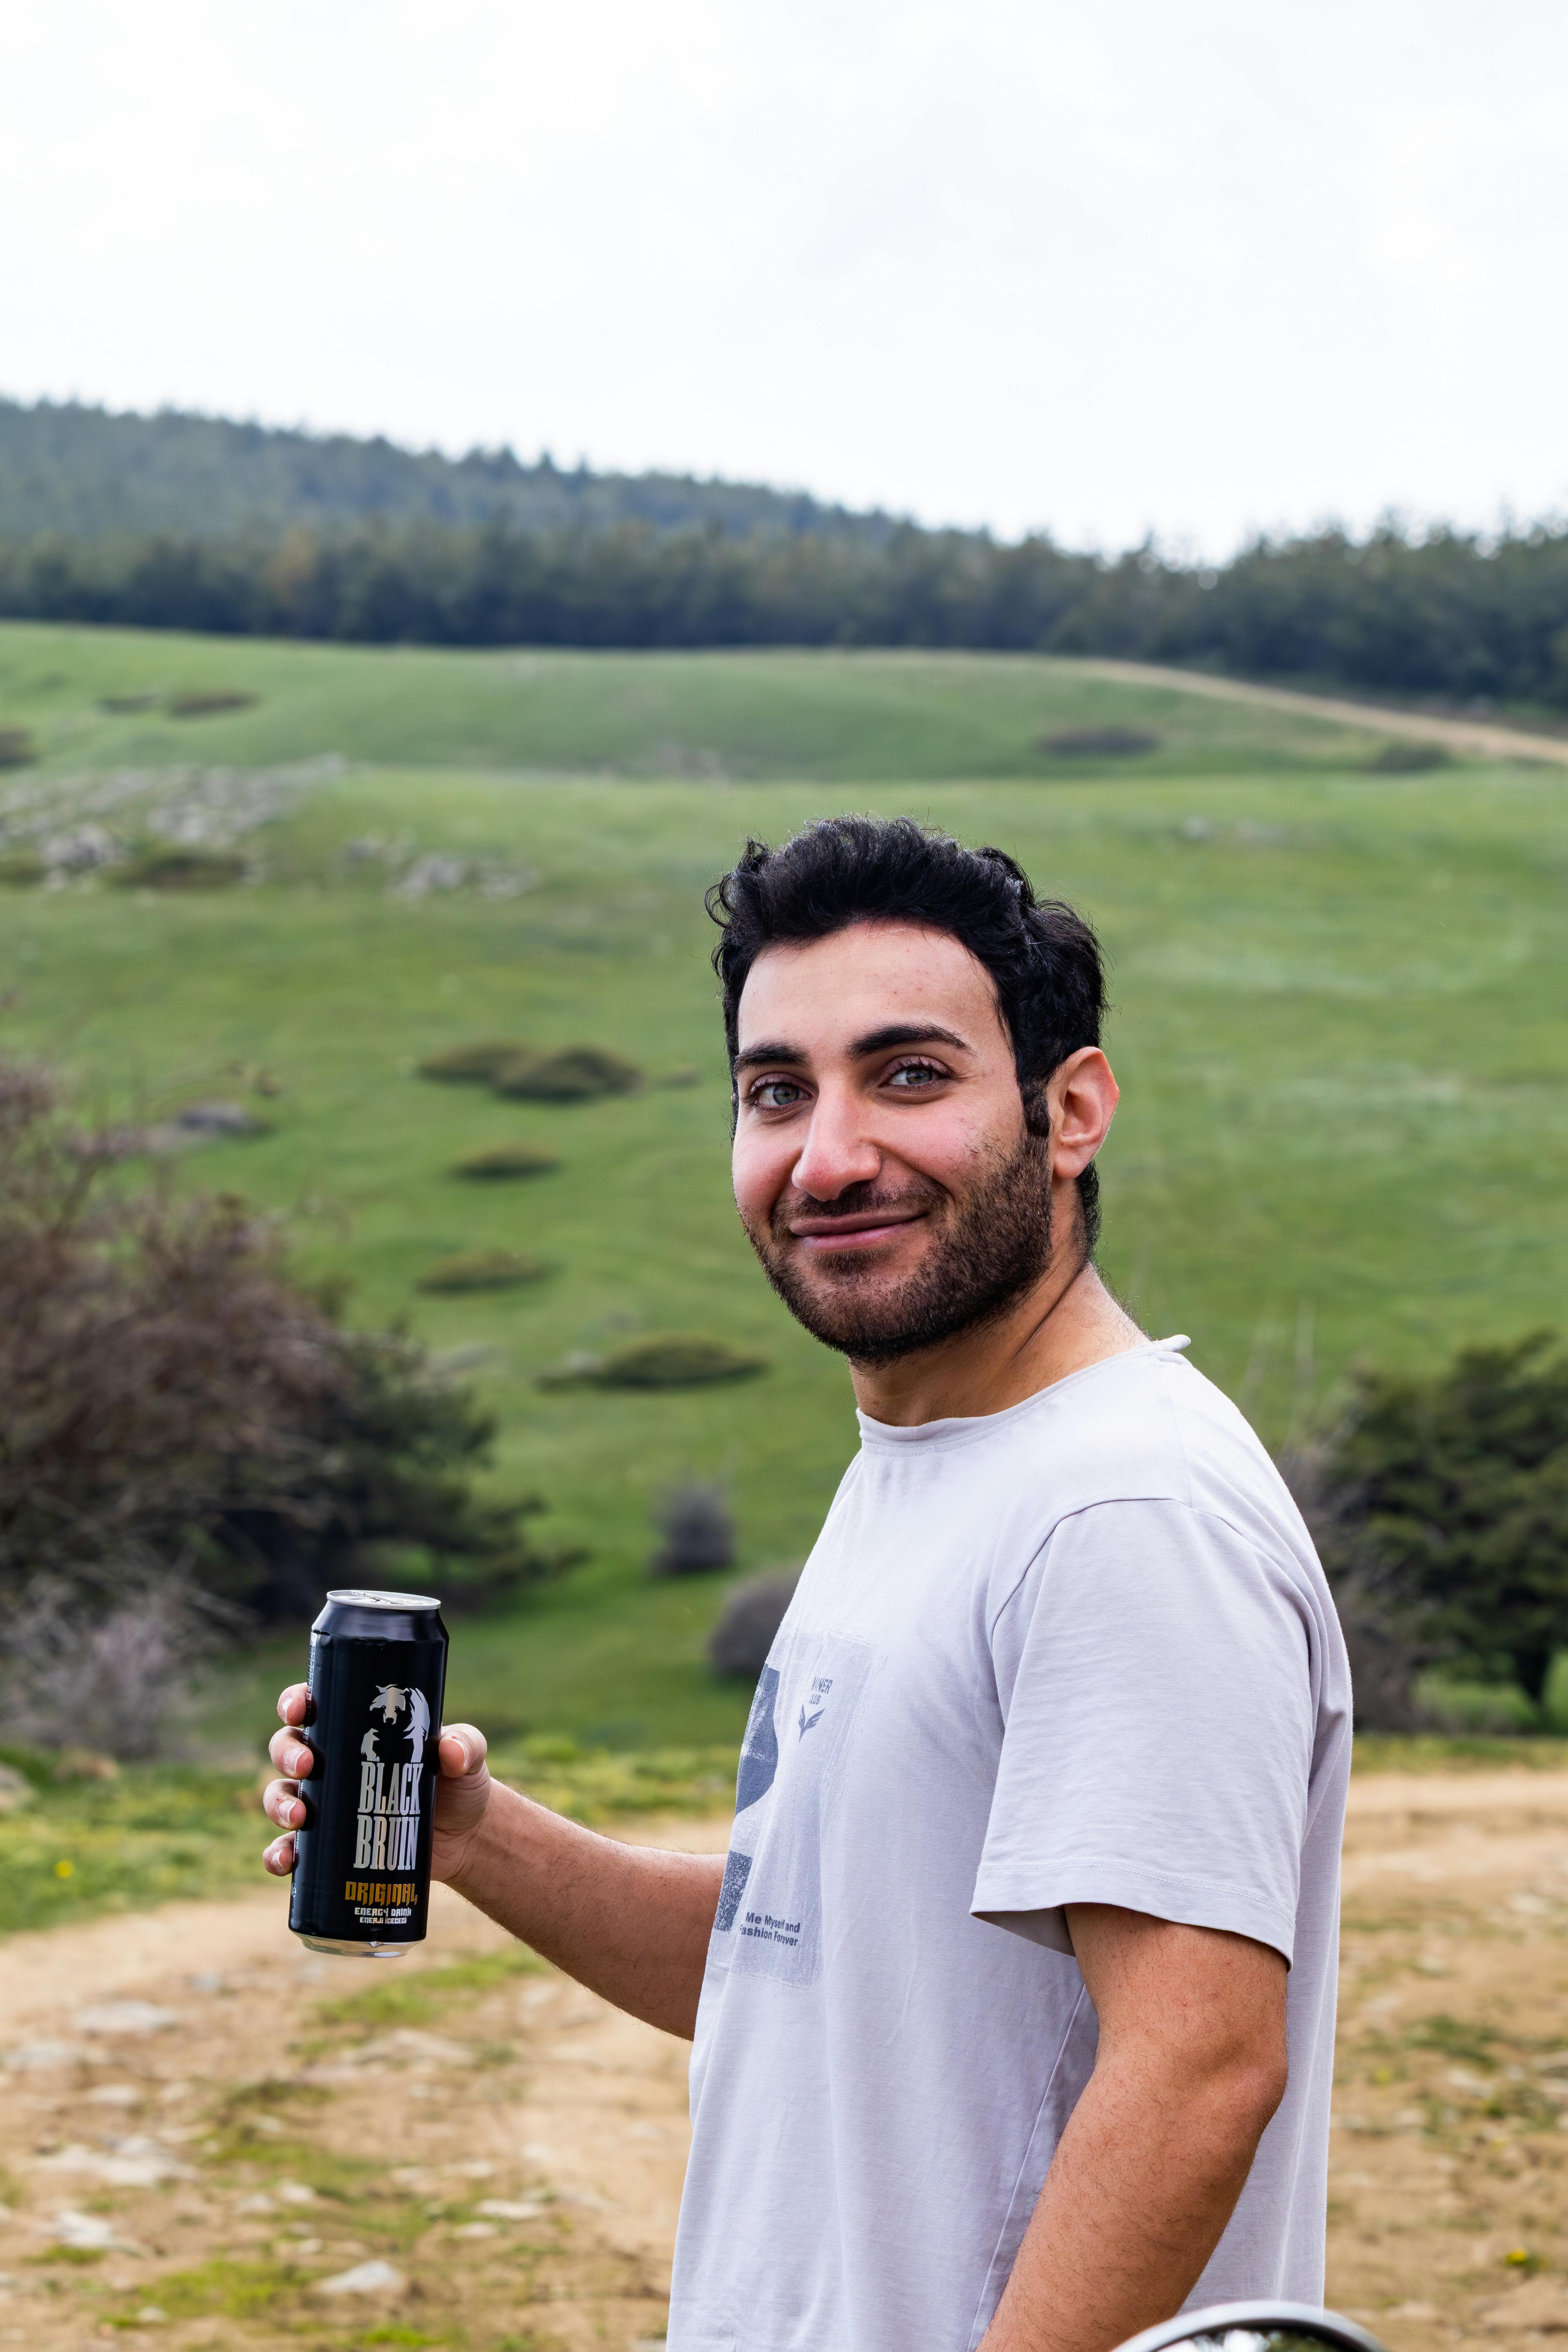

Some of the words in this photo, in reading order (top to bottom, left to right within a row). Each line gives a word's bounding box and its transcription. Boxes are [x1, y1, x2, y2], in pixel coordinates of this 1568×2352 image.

[358, 1761, 423, 1816] BLACK
[353, 1815, 420, 1871] BRUIN
[345, 1881, 418, 1907] ORIGINAL
[354, 1907, 388, 1917] ENERGY
[390, 1907, 412, 1917] DRINK
[746, 1912, 762, 1924] Me
[765, 1915, 785, 1929] Myself
[785, 1922, 800, 1933] and
